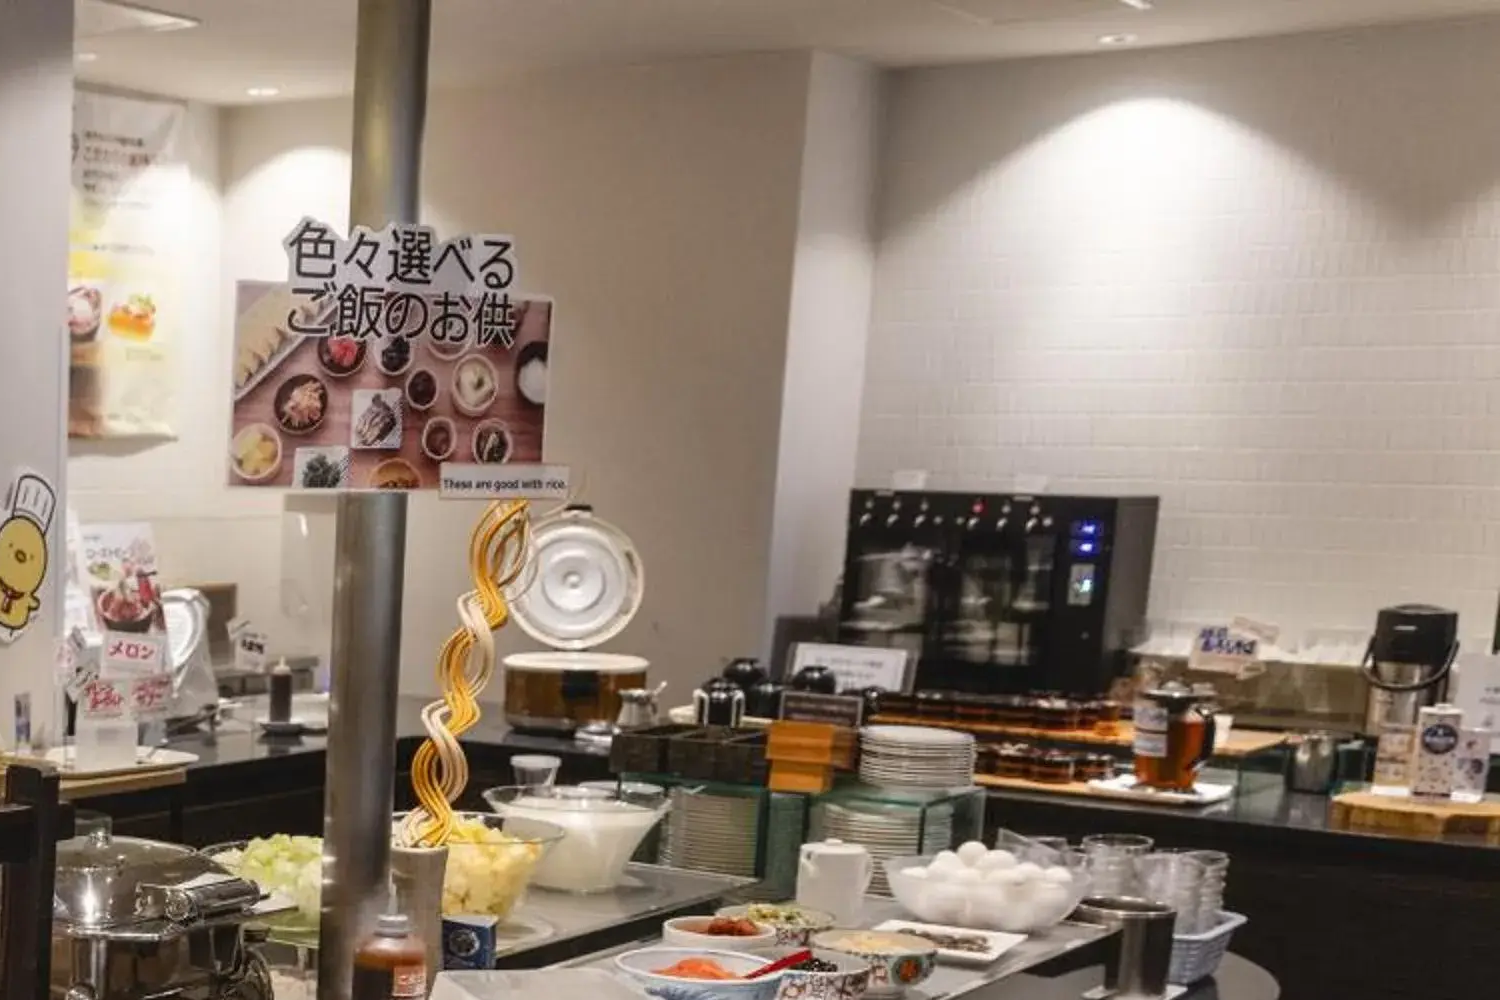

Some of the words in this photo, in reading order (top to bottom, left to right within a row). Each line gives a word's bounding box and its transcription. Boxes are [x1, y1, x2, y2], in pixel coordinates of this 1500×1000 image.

[288, 221, 514, 290] 色々選べる
[286, 281, 517, 347] ご飯のお供
[444, 479, 473, 489] These
[475, 480, 492, 489] are
[493, 480, 519, 492] good
[521, 478, 543, 489] with
[109, 641, 155, 660] メロン
